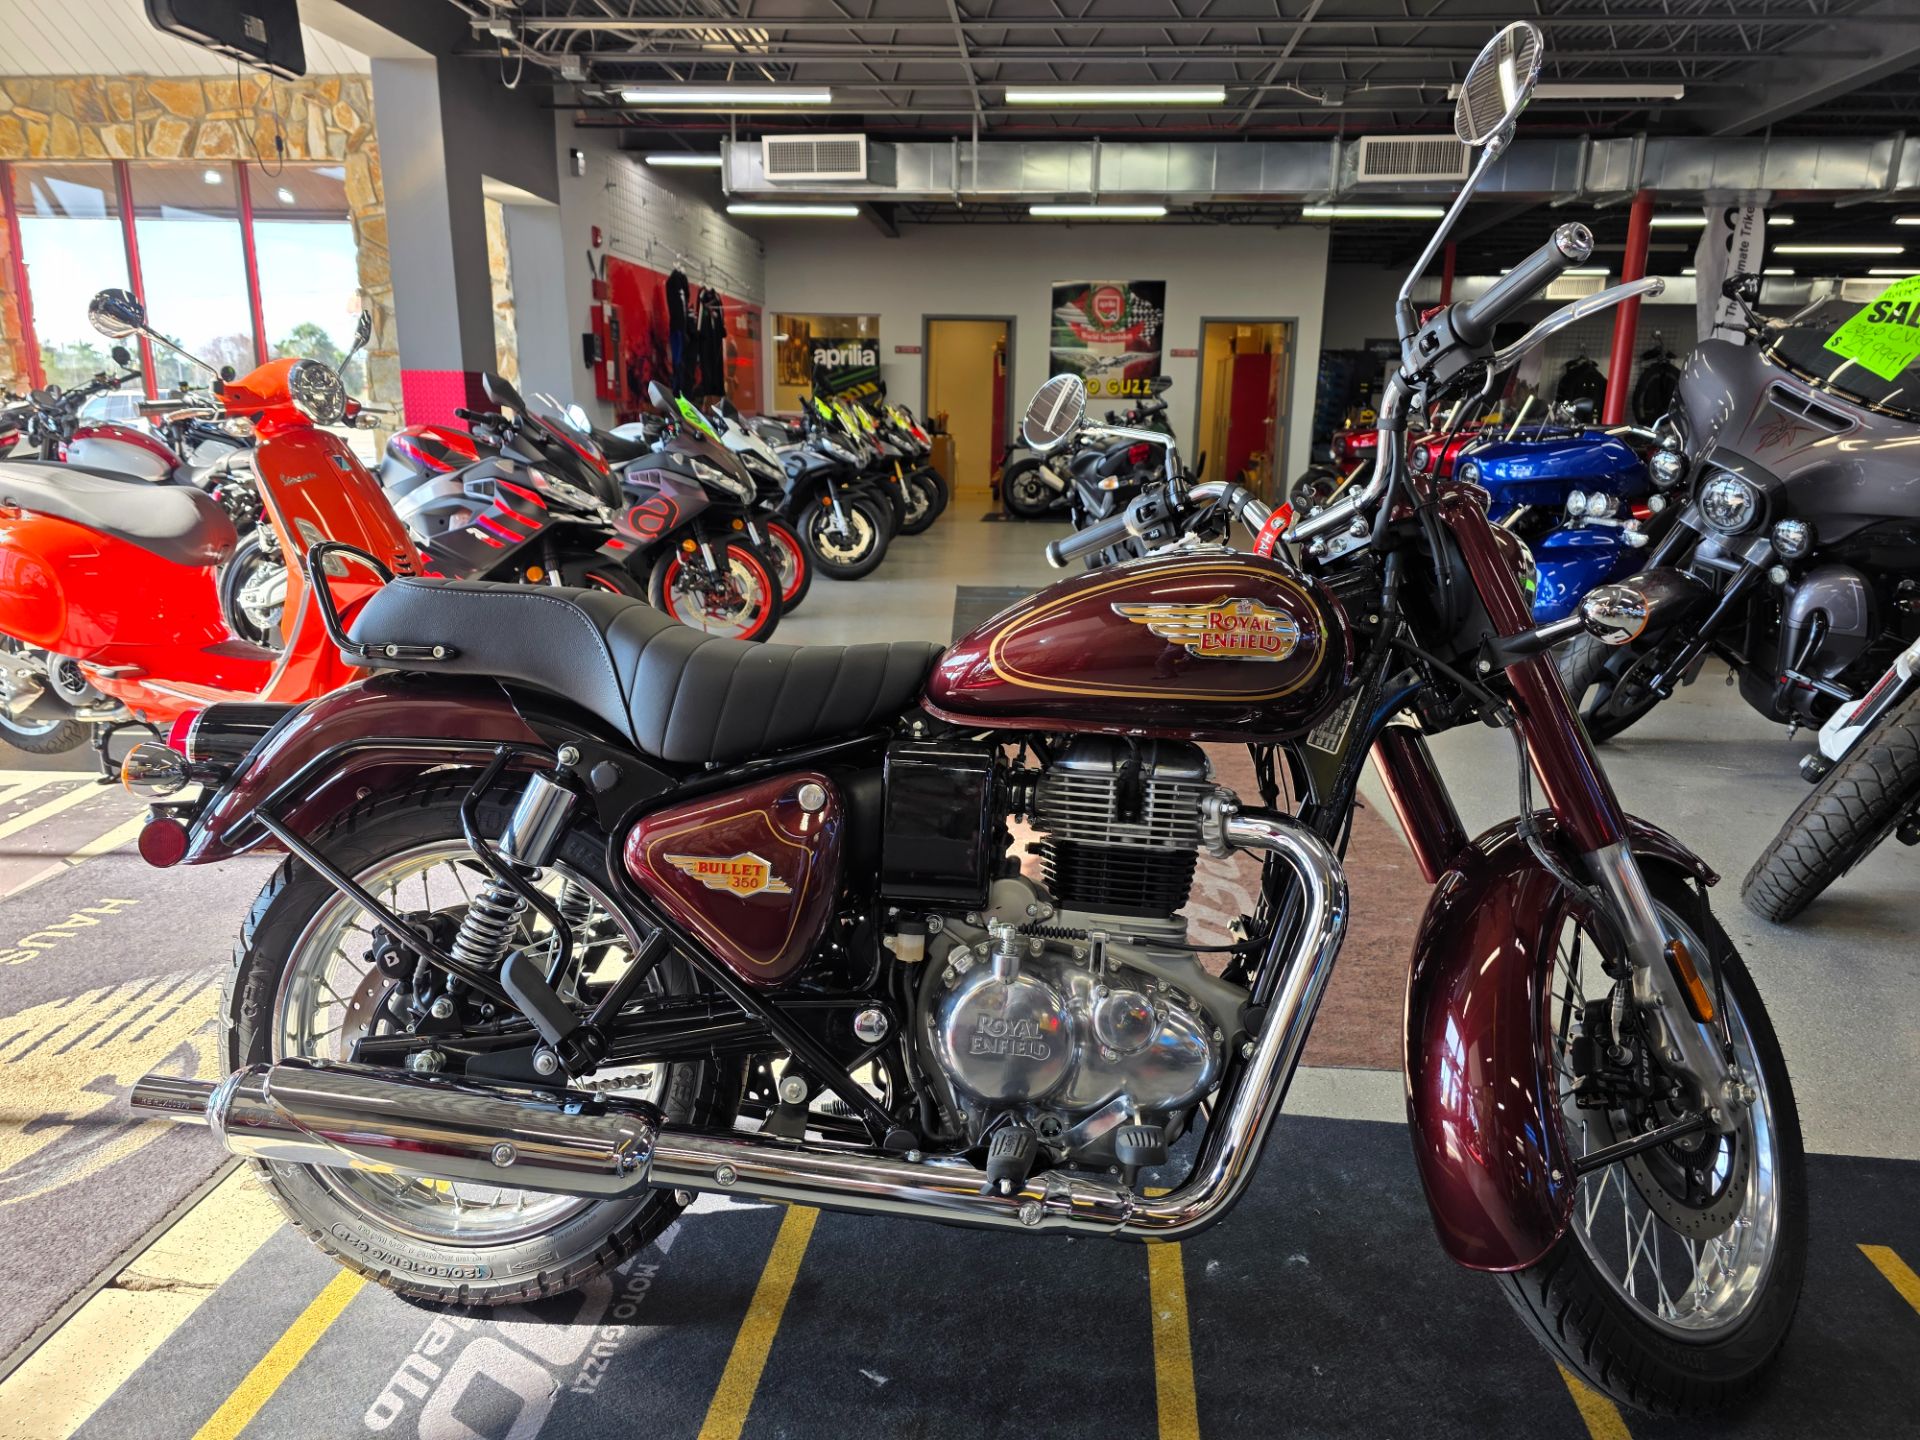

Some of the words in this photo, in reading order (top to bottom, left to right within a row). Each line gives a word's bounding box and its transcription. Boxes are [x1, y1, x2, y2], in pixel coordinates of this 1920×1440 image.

[1725, 300, 1738, 317] Th
[1740, 206, 1755, 237] Trike
[1867, 301, 1920, 329] SAL
[813, 343, 876, 370] aprilia
[1106, 377, 1153, 395] GUZZ
[1208, 611, 1276, 632] ROYAL
[1200, 632, 1282, 653] ENFIELD
[697, 861, 764, 877] BULLET
[732, 876, 759, 889] 350
[976, 1012, 1043, 1039] ROYAL
[968, 1033, 1051, 1061] ENFIELD
[612, 1262, 660, 1319] MOTO
[570, 1324, 626, 1394] GUZZI
